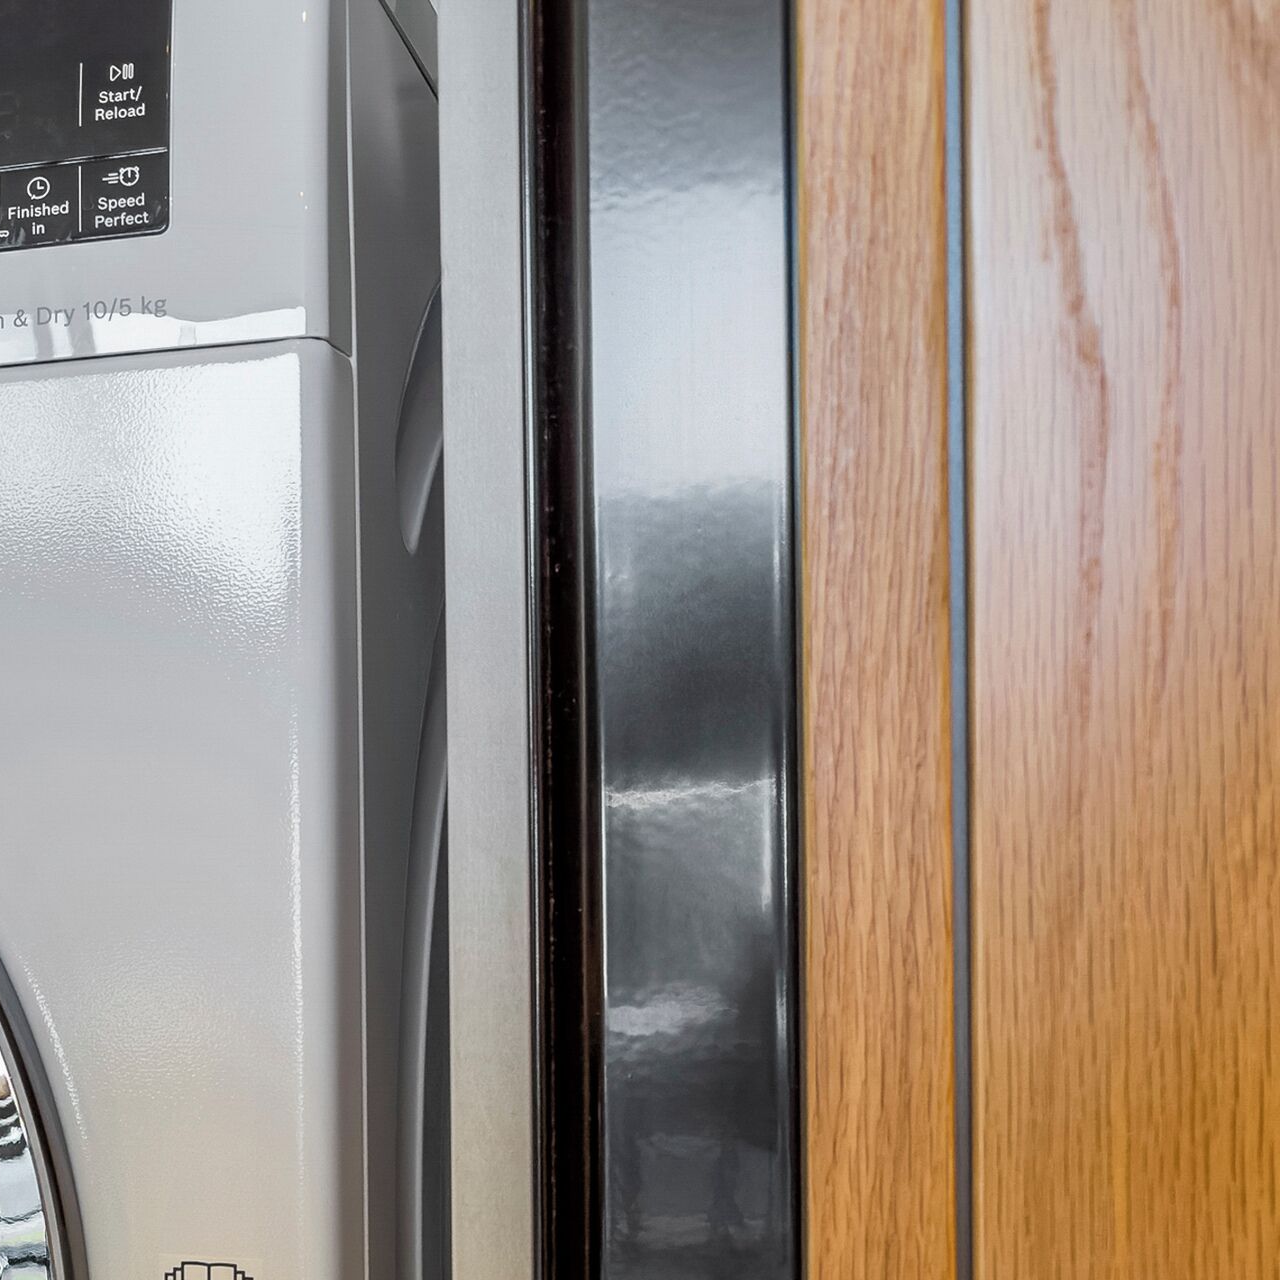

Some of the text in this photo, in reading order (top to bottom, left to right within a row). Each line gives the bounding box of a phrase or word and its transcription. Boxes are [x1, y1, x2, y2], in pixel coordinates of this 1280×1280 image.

[98, 85, 143, 104] Start/
[94, 103, 146, 122] Reload
[8, 200, 69, 220] Finished
[97, 192, 145, 212] Speed
[31, 222, 45, 235] in
[94, 211, 149, 229] Perfect
[13, 308, 28, 328] &
[36, 306, 76, 327] Dry
[82, 297, 132, 322] 10/5
[140, 295, 168, 318] kg
